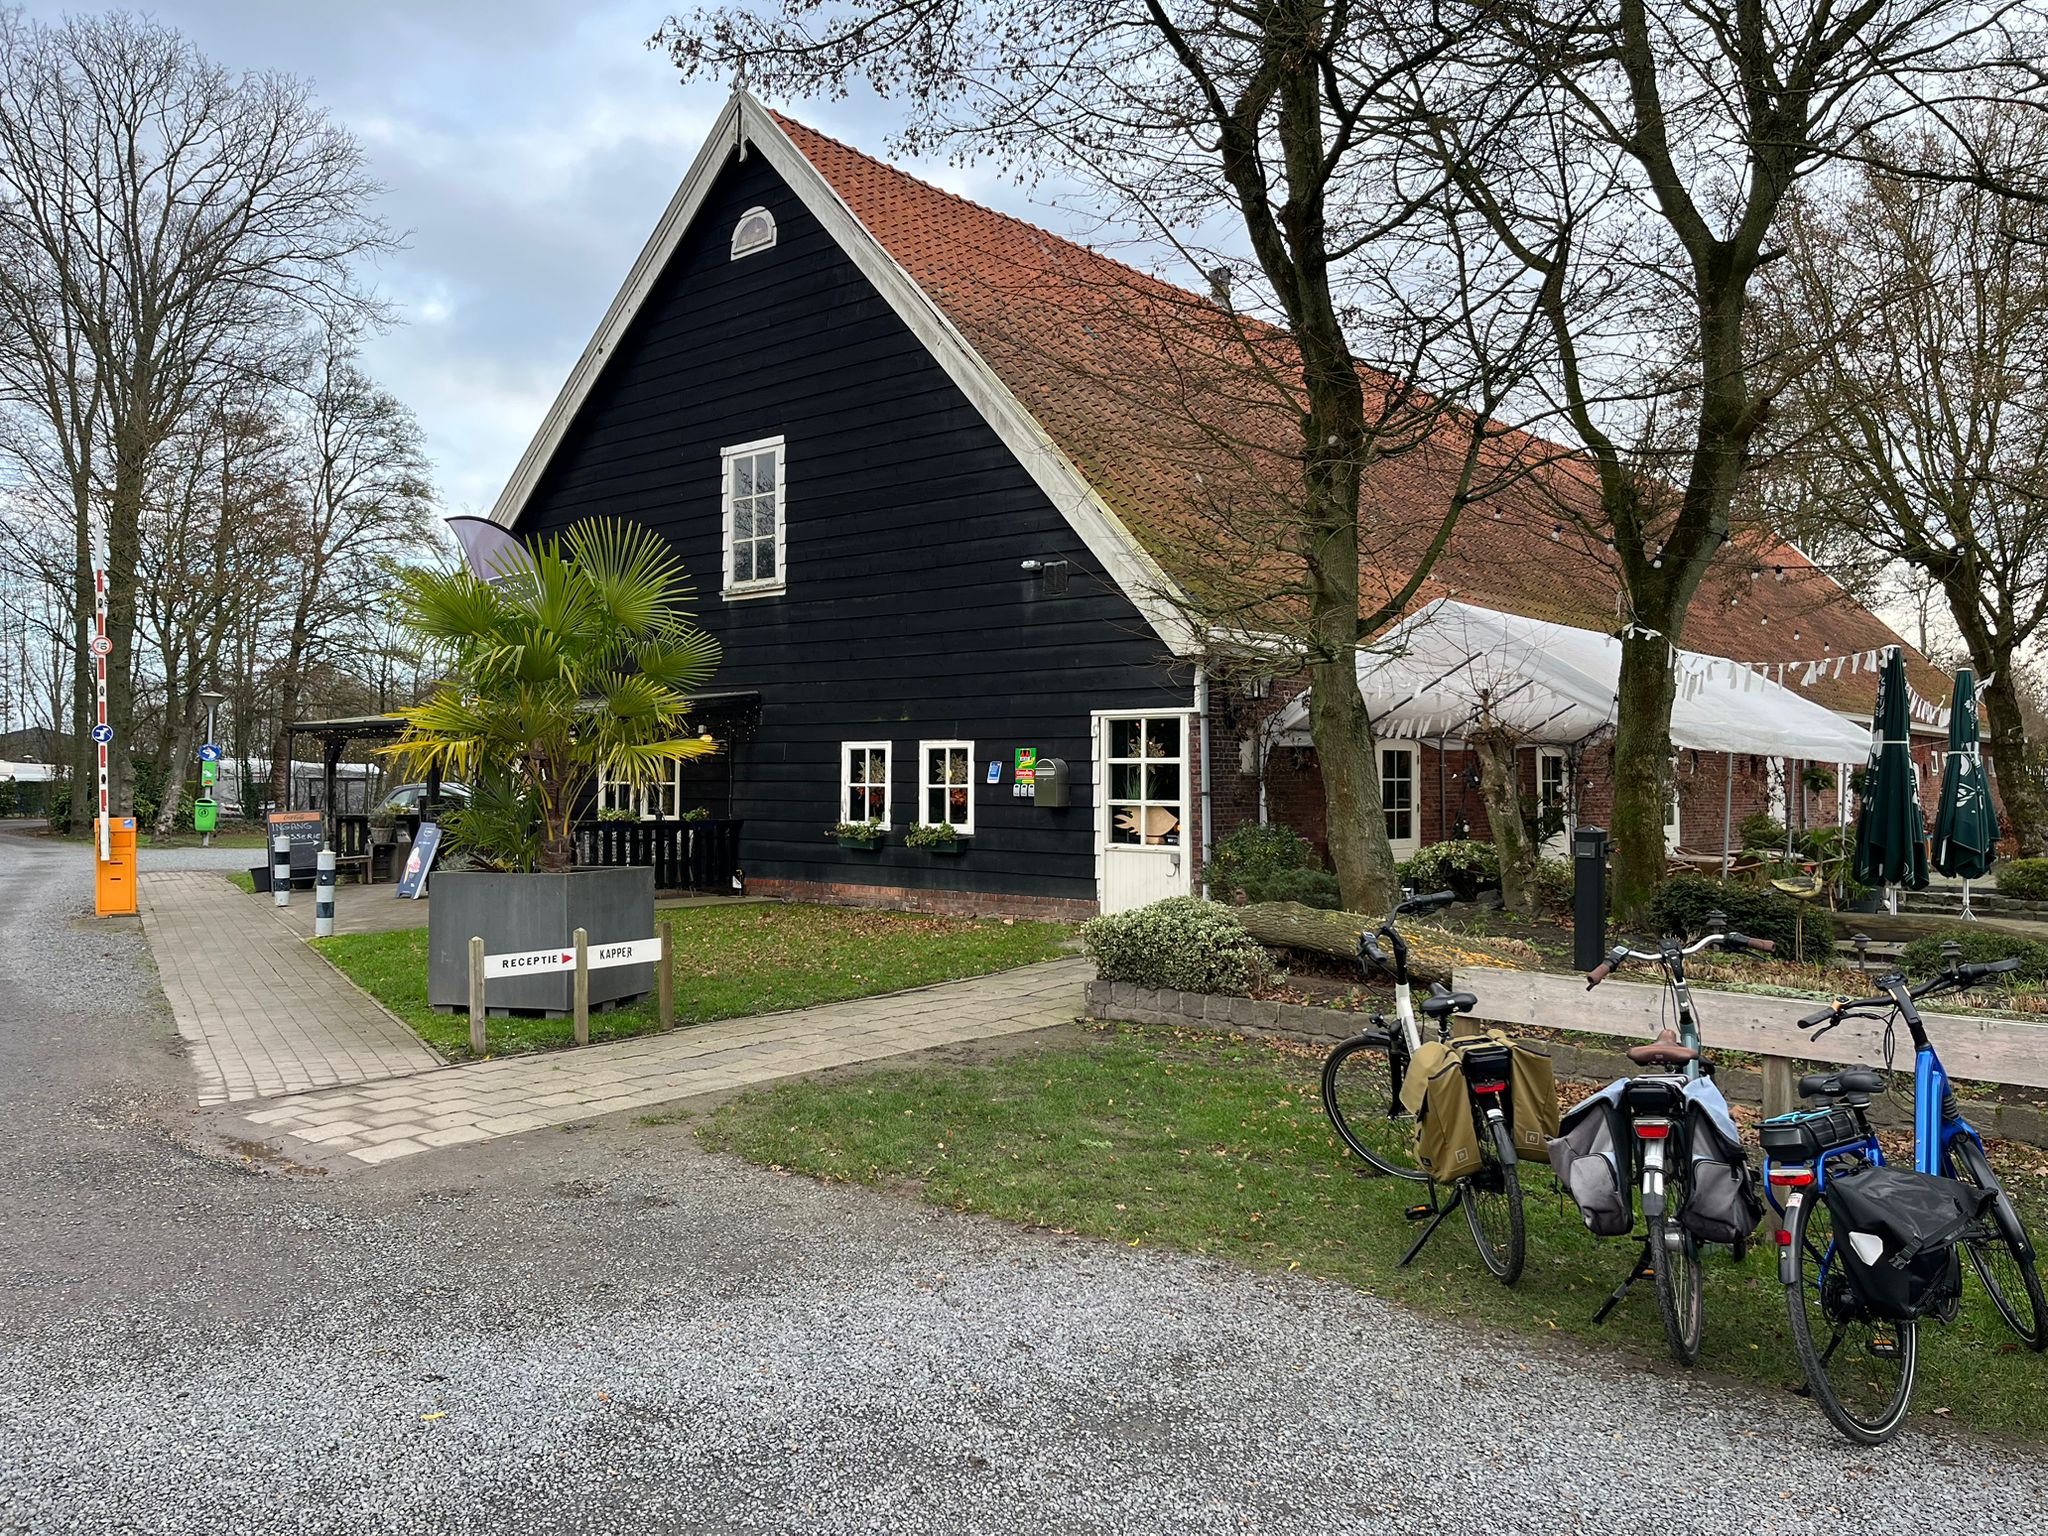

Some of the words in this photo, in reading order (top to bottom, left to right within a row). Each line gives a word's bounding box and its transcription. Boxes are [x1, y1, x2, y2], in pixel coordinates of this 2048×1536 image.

[272, 823, 312, 831] INGANG
[599, 947, 633, 960] KAPPER
[502, 955, 558, 968] RECEPTIE
